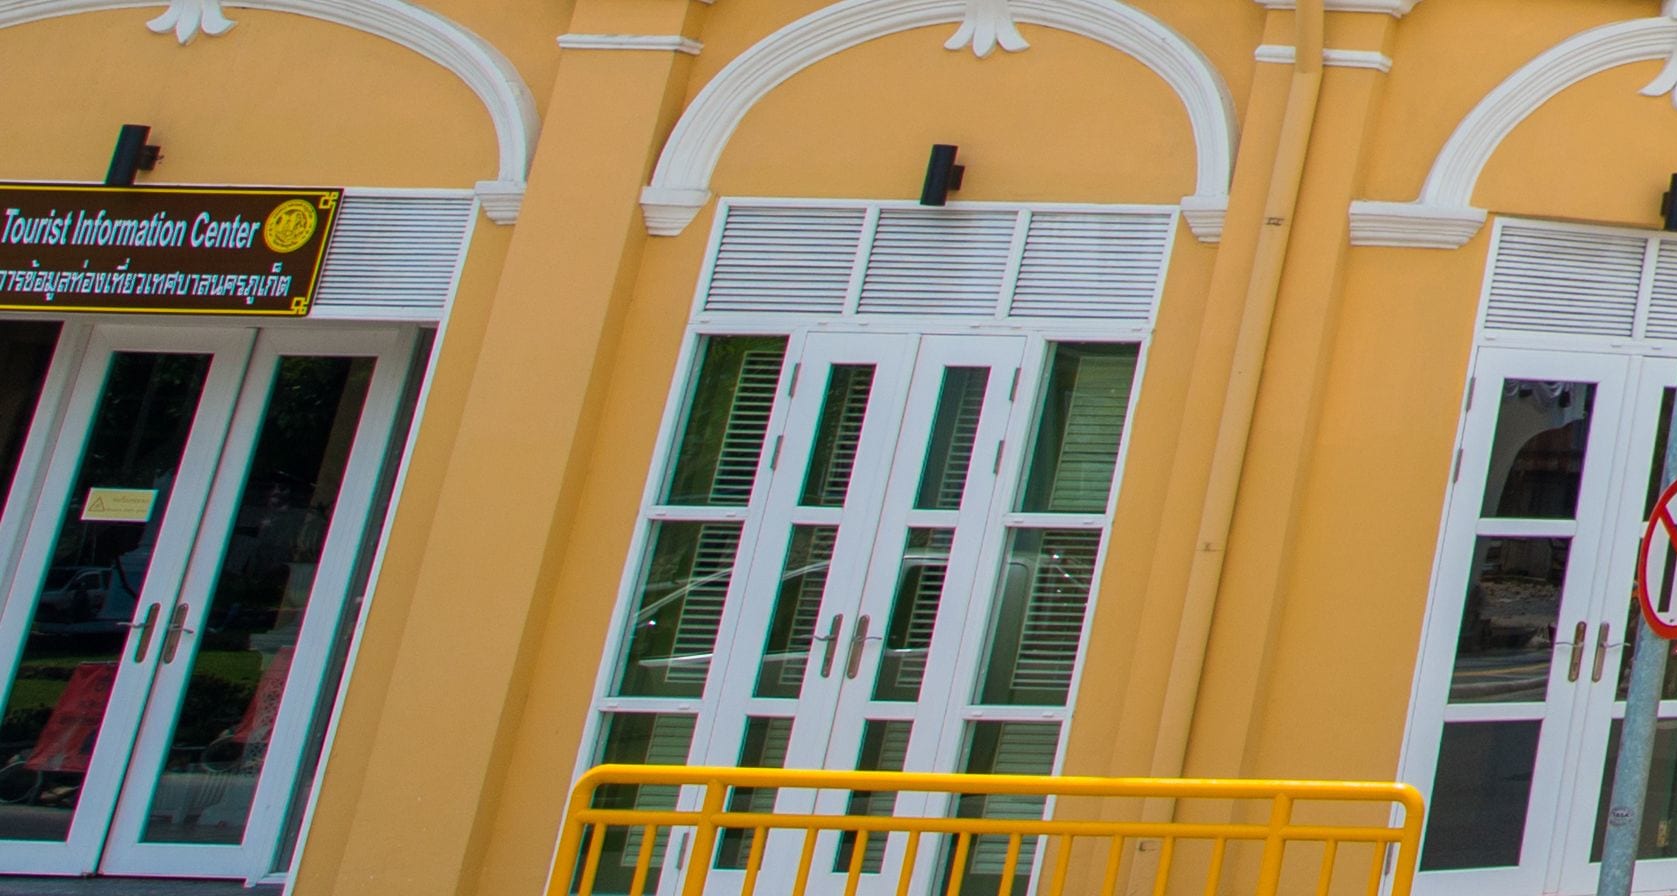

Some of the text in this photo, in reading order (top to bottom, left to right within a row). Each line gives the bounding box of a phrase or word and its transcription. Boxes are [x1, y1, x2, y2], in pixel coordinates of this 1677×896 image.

[1, 208, 262, 249] Tourist Information Center
